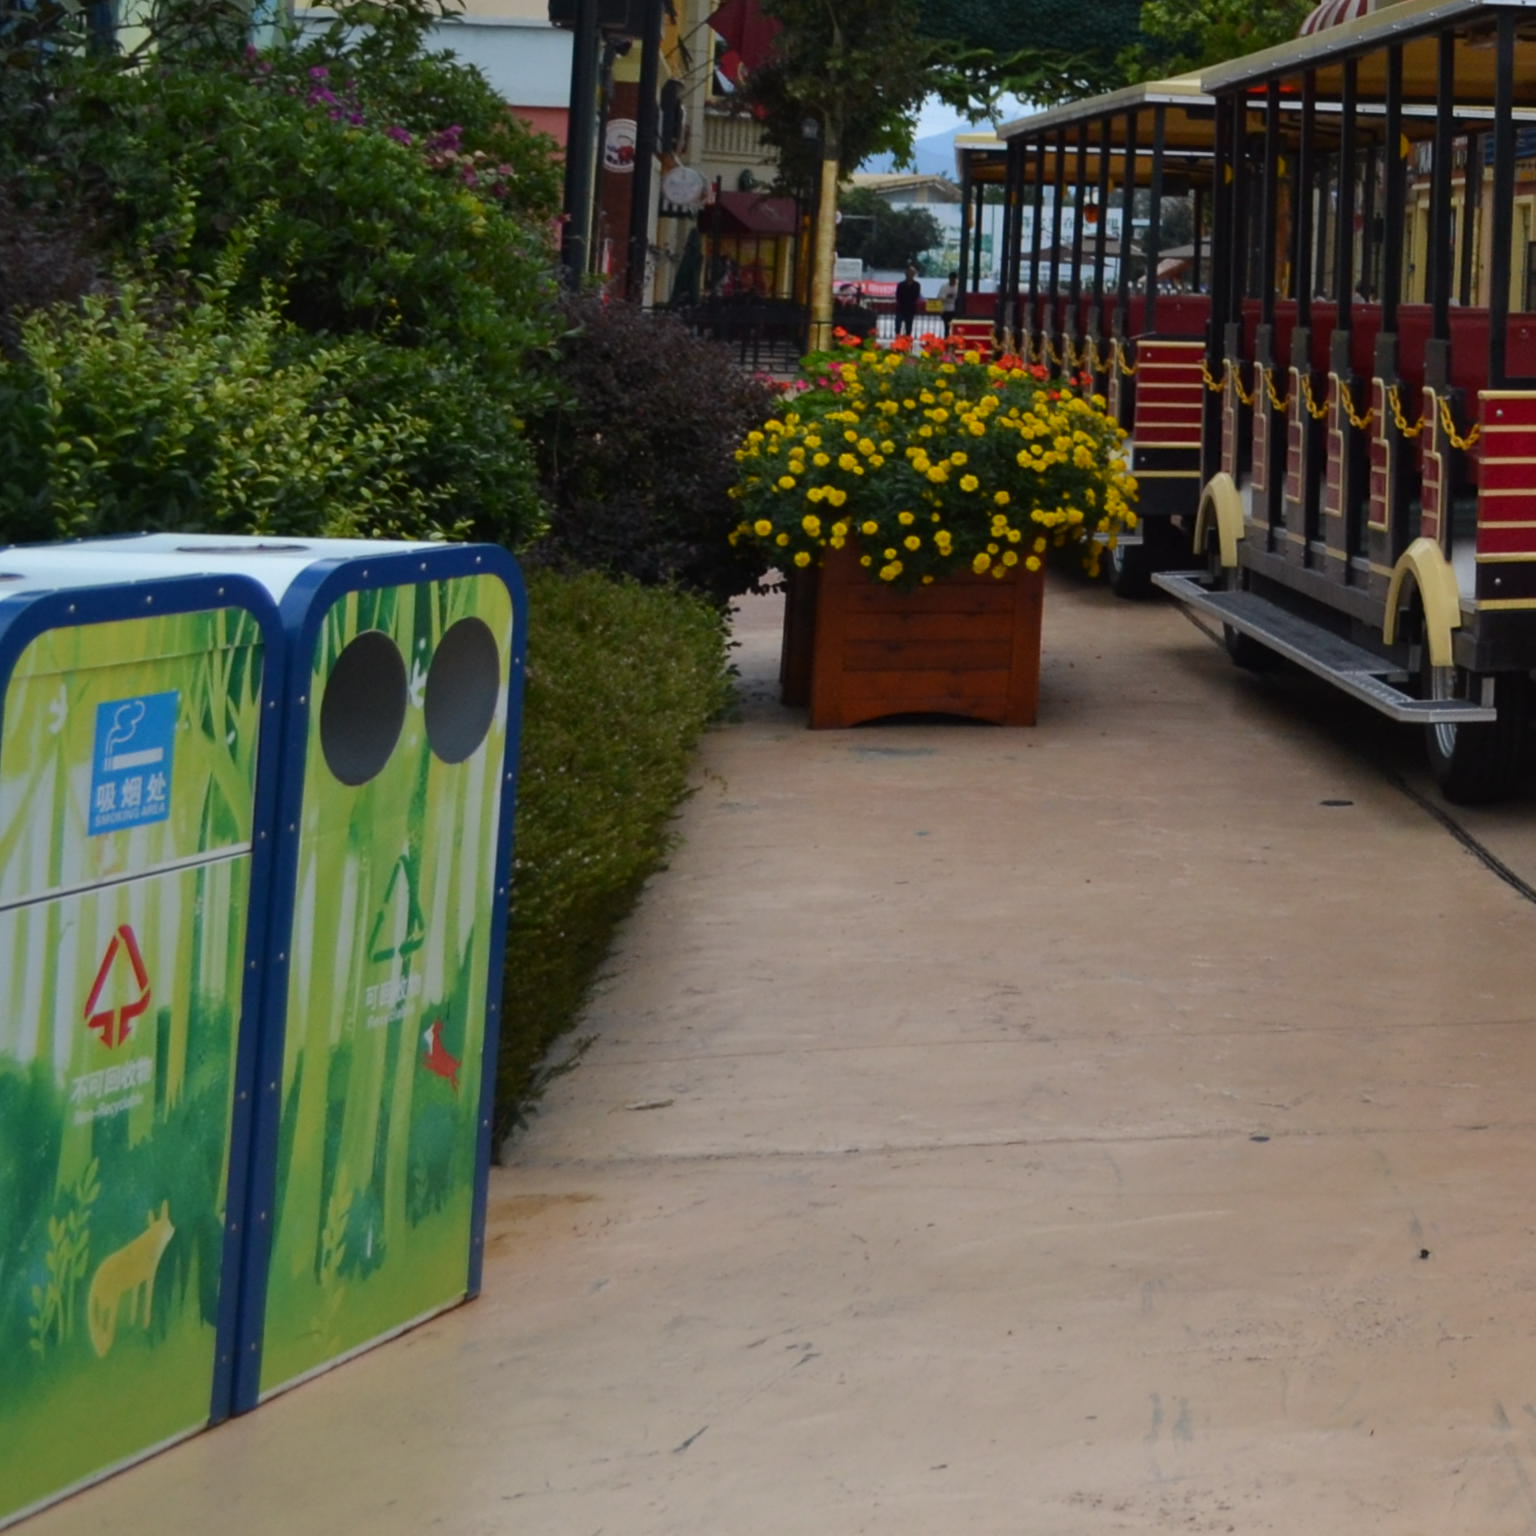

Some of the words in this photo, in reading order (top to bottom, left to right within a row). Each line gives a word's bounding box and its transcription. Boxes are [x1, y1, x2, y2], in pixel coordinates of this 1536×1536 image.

[96, 770, 167, 813] 吸烟处
[70, 1056, 153, 1104] 不可回收物
